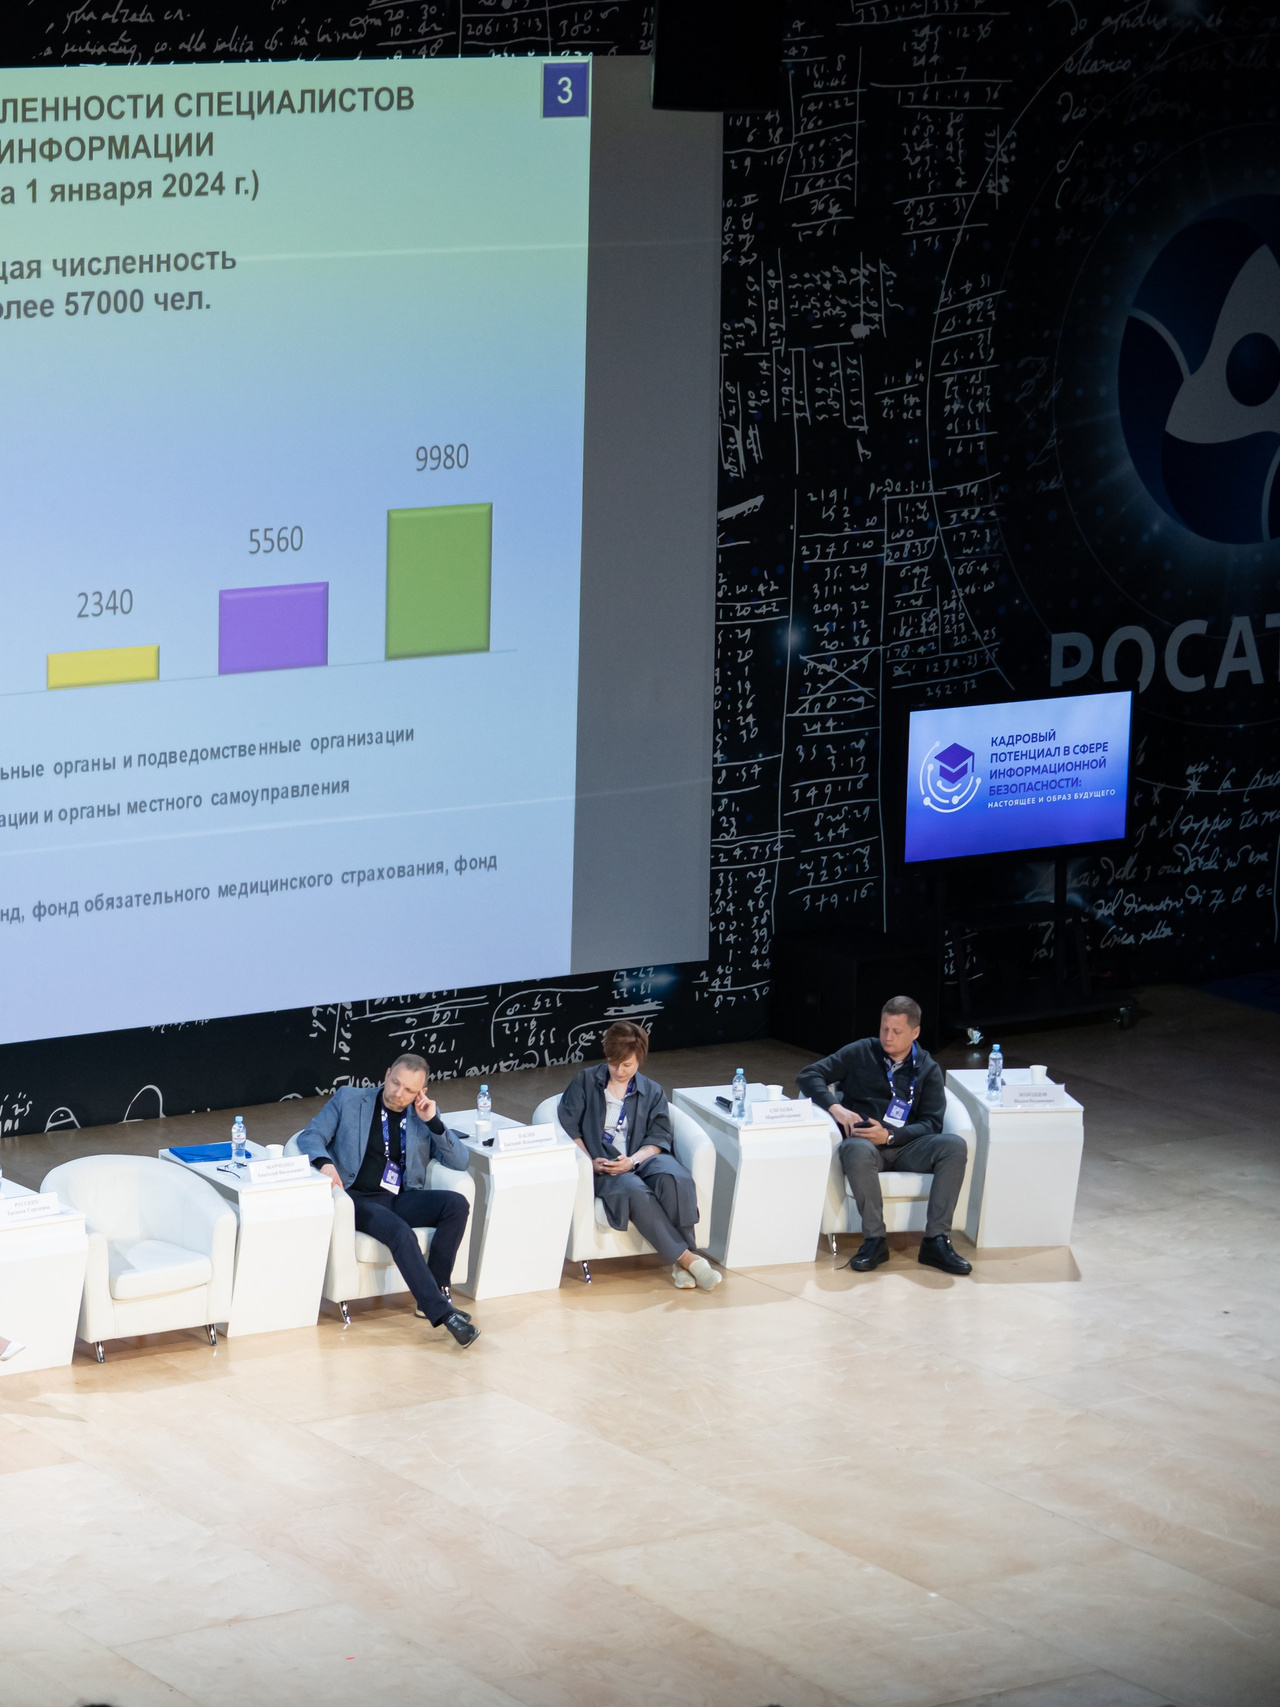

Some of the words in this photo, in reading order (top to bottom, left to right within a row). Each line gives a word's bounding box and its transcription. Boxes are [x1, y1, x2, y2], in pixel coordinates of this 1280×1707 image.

[175, 87, 414, 120] СПЕЦИАЛИСТОВ
[558, 77, 572, 103] 3
[27, 179, 36, 203] 1
[50, 181, 152, 206] января
[163, 171, 225, 197] 2024
[236, 170, 259, 201] г.)
[53, 251, 236, 277] численность
[65, 289, 143, 316] 57000
[154, 291, 210, 311] чел.
[416, 444, 468, 471] 9980
[249, 526, 303, 554] 5560
[77, 589, 133, 618] 2340
[991, 729, 1056, 748] КАДРОВЫЙ
[54, 757, 115, 778] органы
[124, 755, 132, 768] и
[138, 740, 301, 768] подведомственные
[311, 729, 414, 754] организации
[990, 746, 1060, 764] ПОТЕНЦИАЛ
[1063, 746, 1070, 756] В
[1073, 741, 1109, 755] СФЕРЕ
[990, 755, 1107, 780] ИНФОРМАЦИОННОЙ
[988, 798, 1036, 809] НАСТОЯЩЕЕ
[1047, 794, 1071, 803] ОБРАЗ
[1074, 789, 1116, 800] БУДУЩЕГО
[989, 777, 1082, 797] БЕЗОПАСНОСТИ:
[44, 810, 52, 823] и
[58, 803, 120, 824] органы
[127, 795, 202, 814] местного
[211, 780, 349, 806] самоуправления
[33, 901, 79, 922] фонд
[84, 887, 210, 912] обязательного
[218, 874, 333, 899] медицинского
[341, 861, 448, 887] страхования,
[455, 855, 497, 875] фонд
